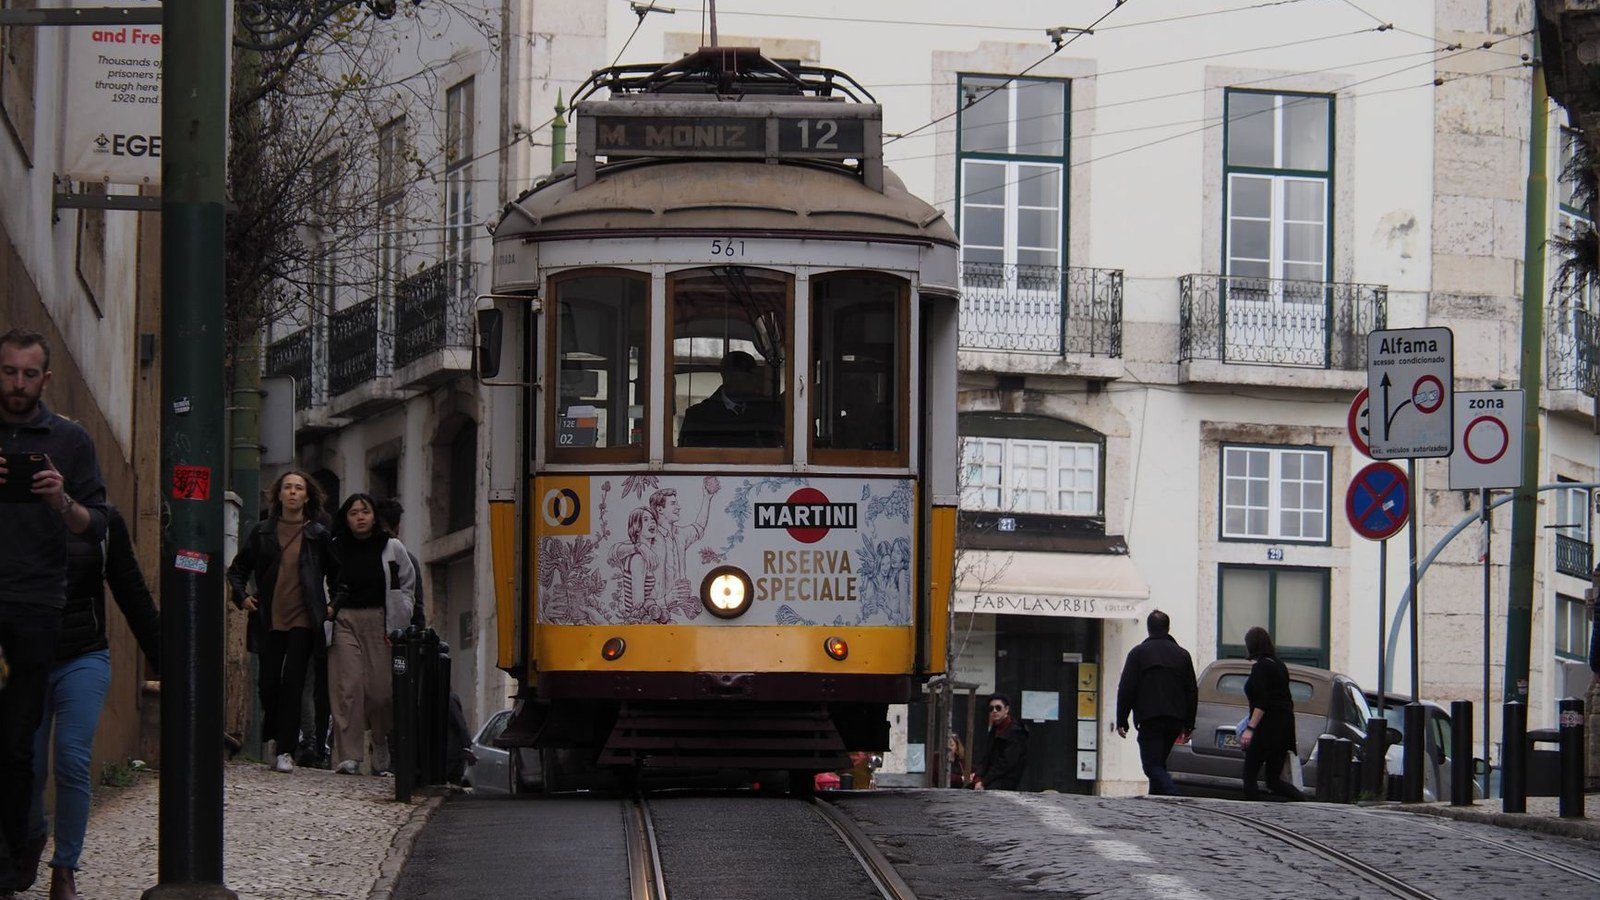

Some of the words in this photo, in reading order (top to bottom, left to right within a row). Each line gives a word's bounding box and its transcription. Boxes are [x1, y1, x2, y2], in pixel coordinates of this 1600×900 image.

[92, 28, 126, 43] and
[132, 28, 161, 44] Fre
[98, 55, 151, 67] Thousands
[107, 69, 154, 79] prisoners
[95, 81, 134, 92] through
[136, 82, 158, 91] here
[112, 94, 136, 103] 1928
[138, 95, 159, 104] and
[600, 124, 630, 147] M.
[645, 125, 747, 148] MONIZ
[797, 119, 839, 150] 12
[711, 239, 745, 257] 561
[1379, 338, 1438, 354] Alfama
[1373, 358, 1395, 366] acesso
[1399, 356, 1445, 365] condicionado
[1469, 398, 1504, 409] zona
[560, 433, 574, 445] 02
[758, 505, 855, 526] MARTINI
[1000, 519, 1011, 529] 27
[1270, 549, 1282, 559] 29
[763, 550, 852, 575] RISERVA
[756, 577, 857, 601] SPECIALE
